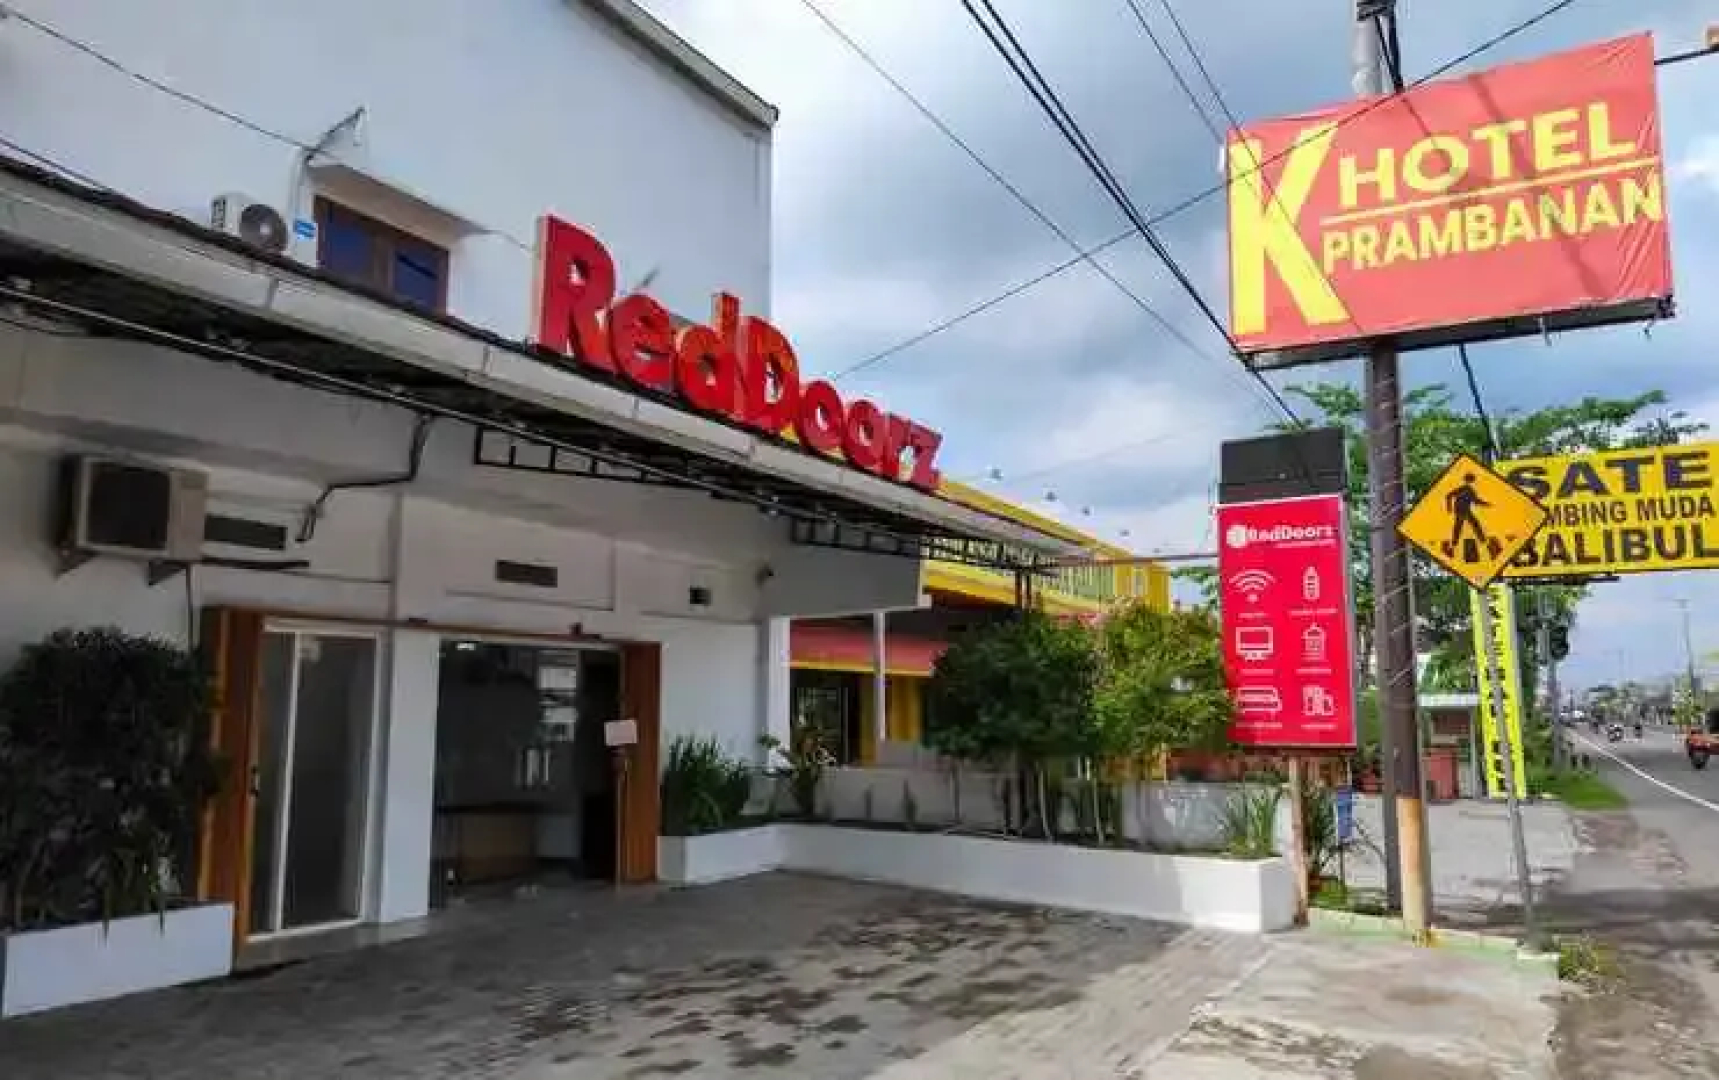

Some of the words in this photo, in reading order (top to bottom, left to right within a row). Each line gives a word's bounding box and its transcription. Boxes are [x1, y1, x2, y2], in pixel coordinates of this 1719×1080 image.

[1338, 102, 1637, 208] HOTEL
[1229, 121, 1350, 336] K
[1322, 173, 1663, 274] PRAMBANAN
[535, 212, 944, 493] RedDoorz
[1507, 450, 1713, 499] SATE
[1546, 500, 1627, 527] MBING
[1636, 493, 1716, 521] MUDA
